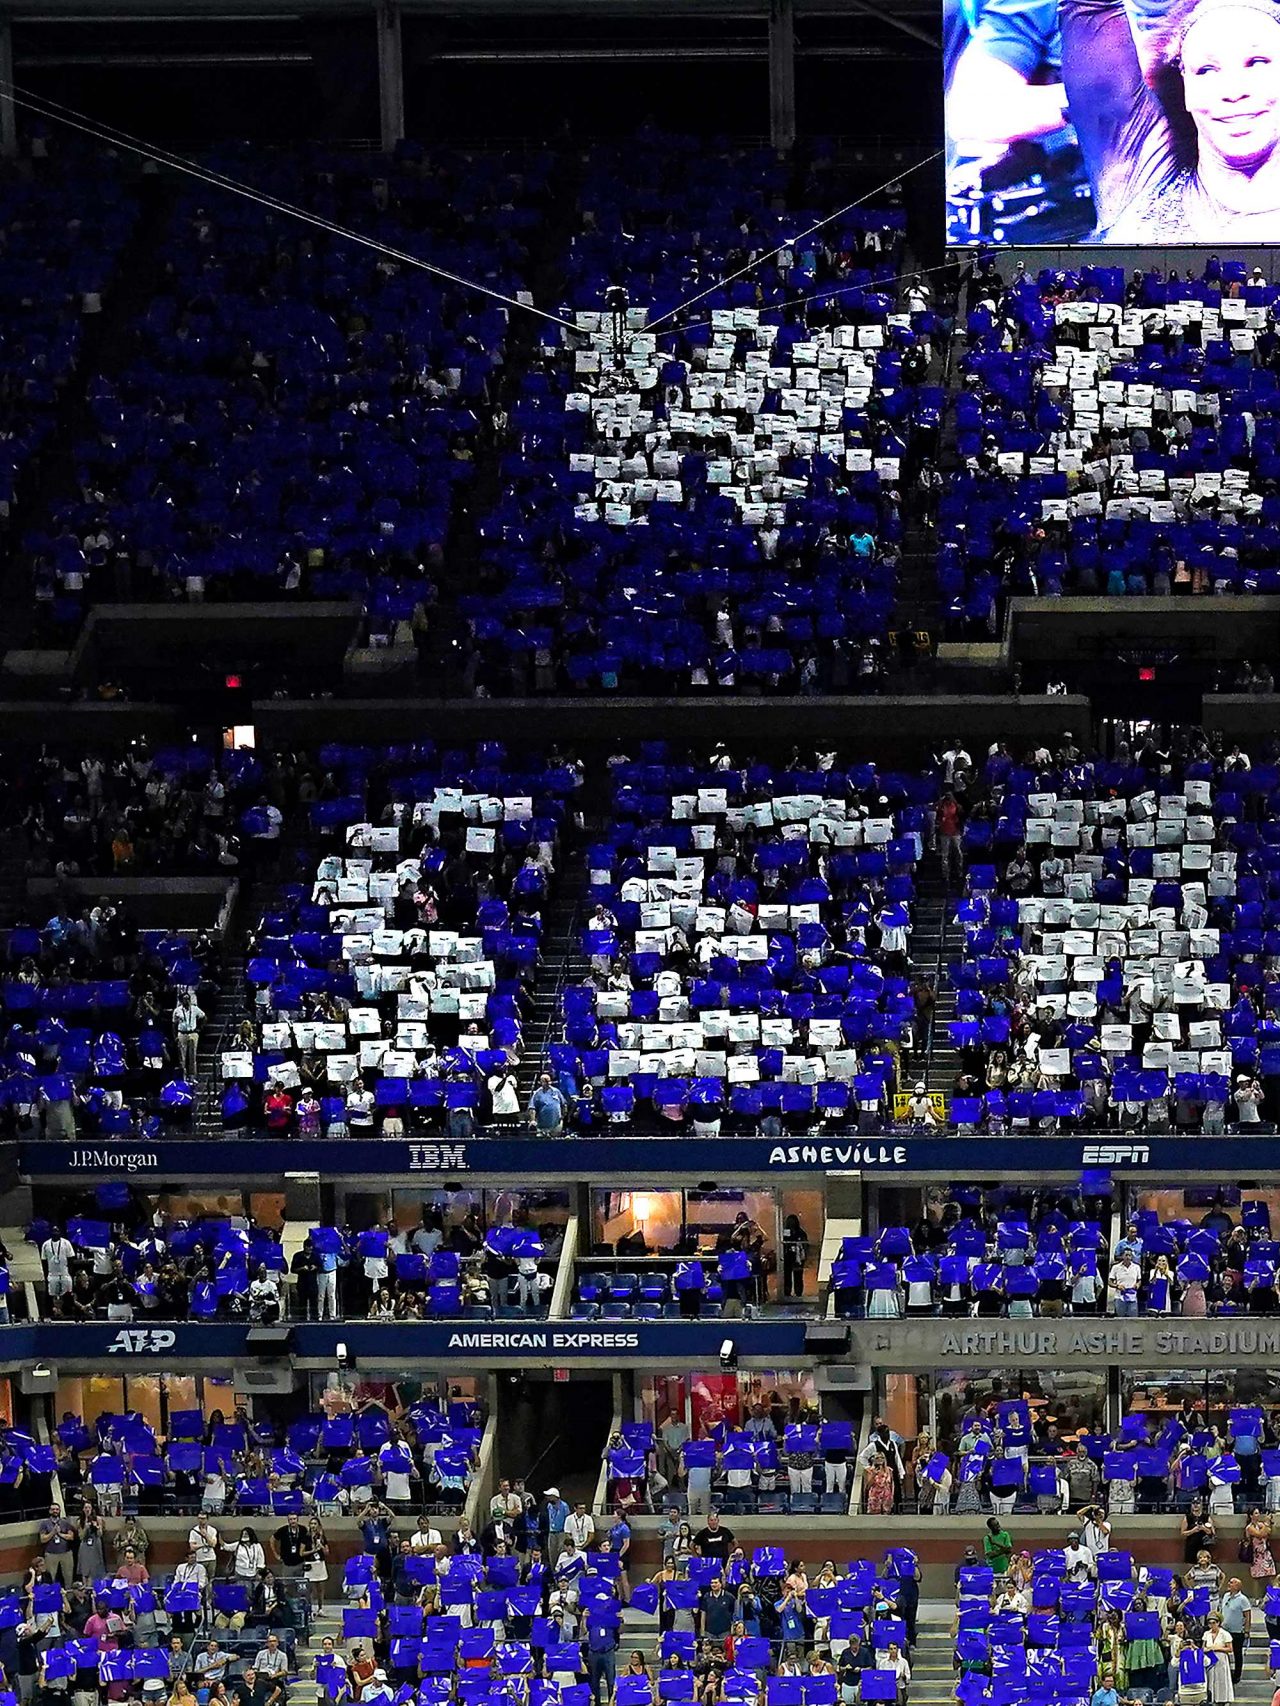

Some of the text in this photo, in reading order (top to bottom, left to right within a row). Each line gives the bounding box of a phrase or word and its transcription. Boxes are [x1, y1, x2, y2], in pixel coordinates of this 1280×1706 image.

[408, 1145, 468, 1168] IBM
[1082, 1145, 1150, 1163] ESPN
[106, 1330, 176, 1352] ATP
[448, 1333, 639, 1348] AMERICAN EXPRESS
[941, 1331, 1280, 1355] ARTHUR ASHE STADIUM
